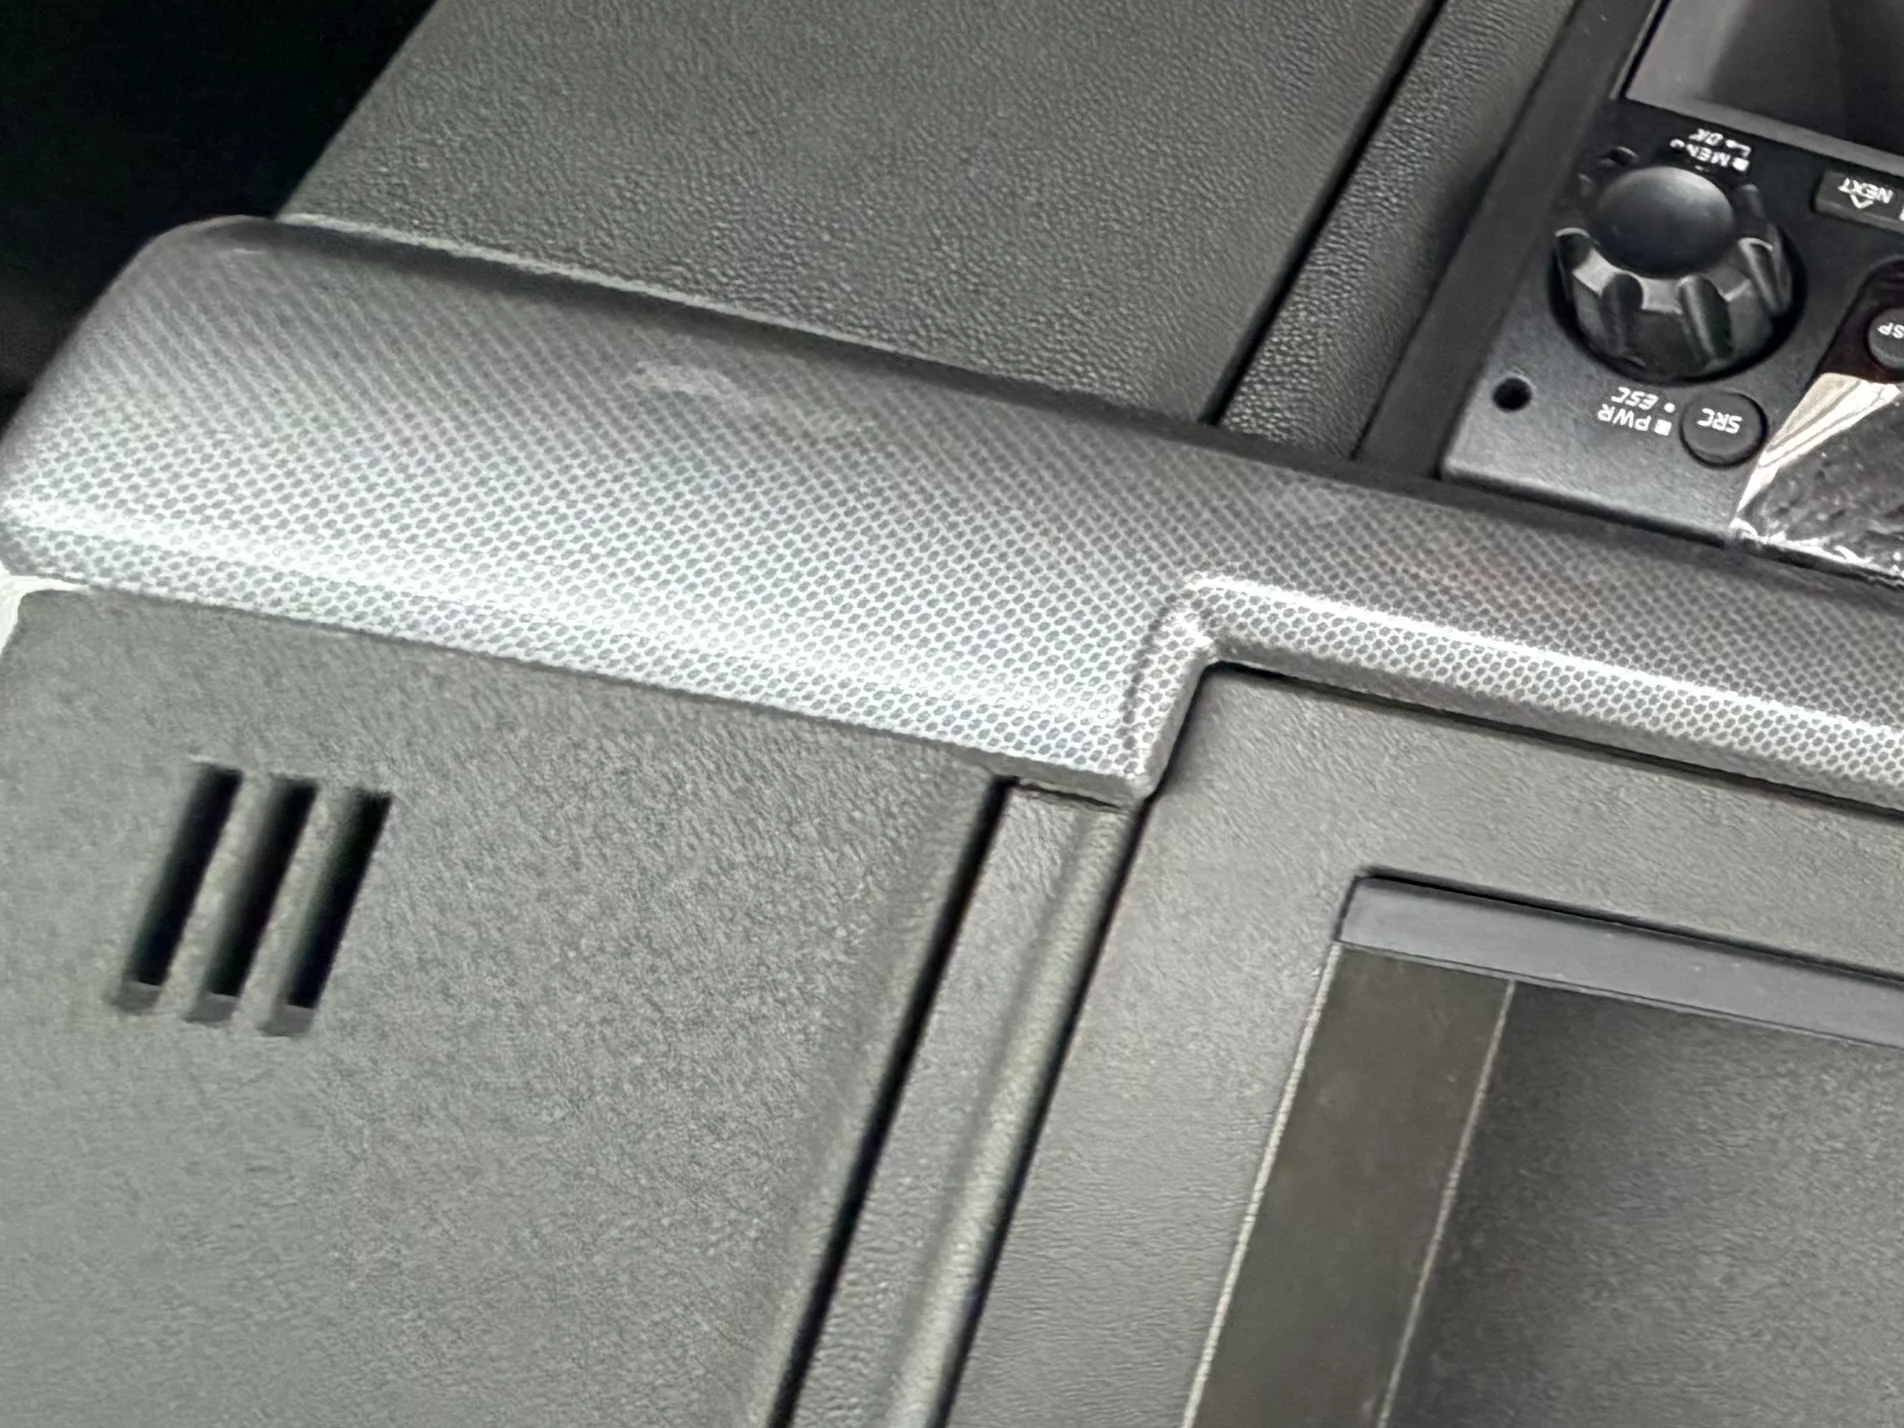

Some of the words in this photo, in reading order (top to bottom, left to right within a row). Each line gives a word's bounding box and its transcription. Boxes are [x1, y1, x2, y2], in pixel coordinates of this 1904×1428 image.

[1838, 176, 1894, 204] NEXT
[1611, 386, 1659, 410] ESC
[1598, 403, 1651, 431] PWR
[1697, 408, 1742, 433] SRC
